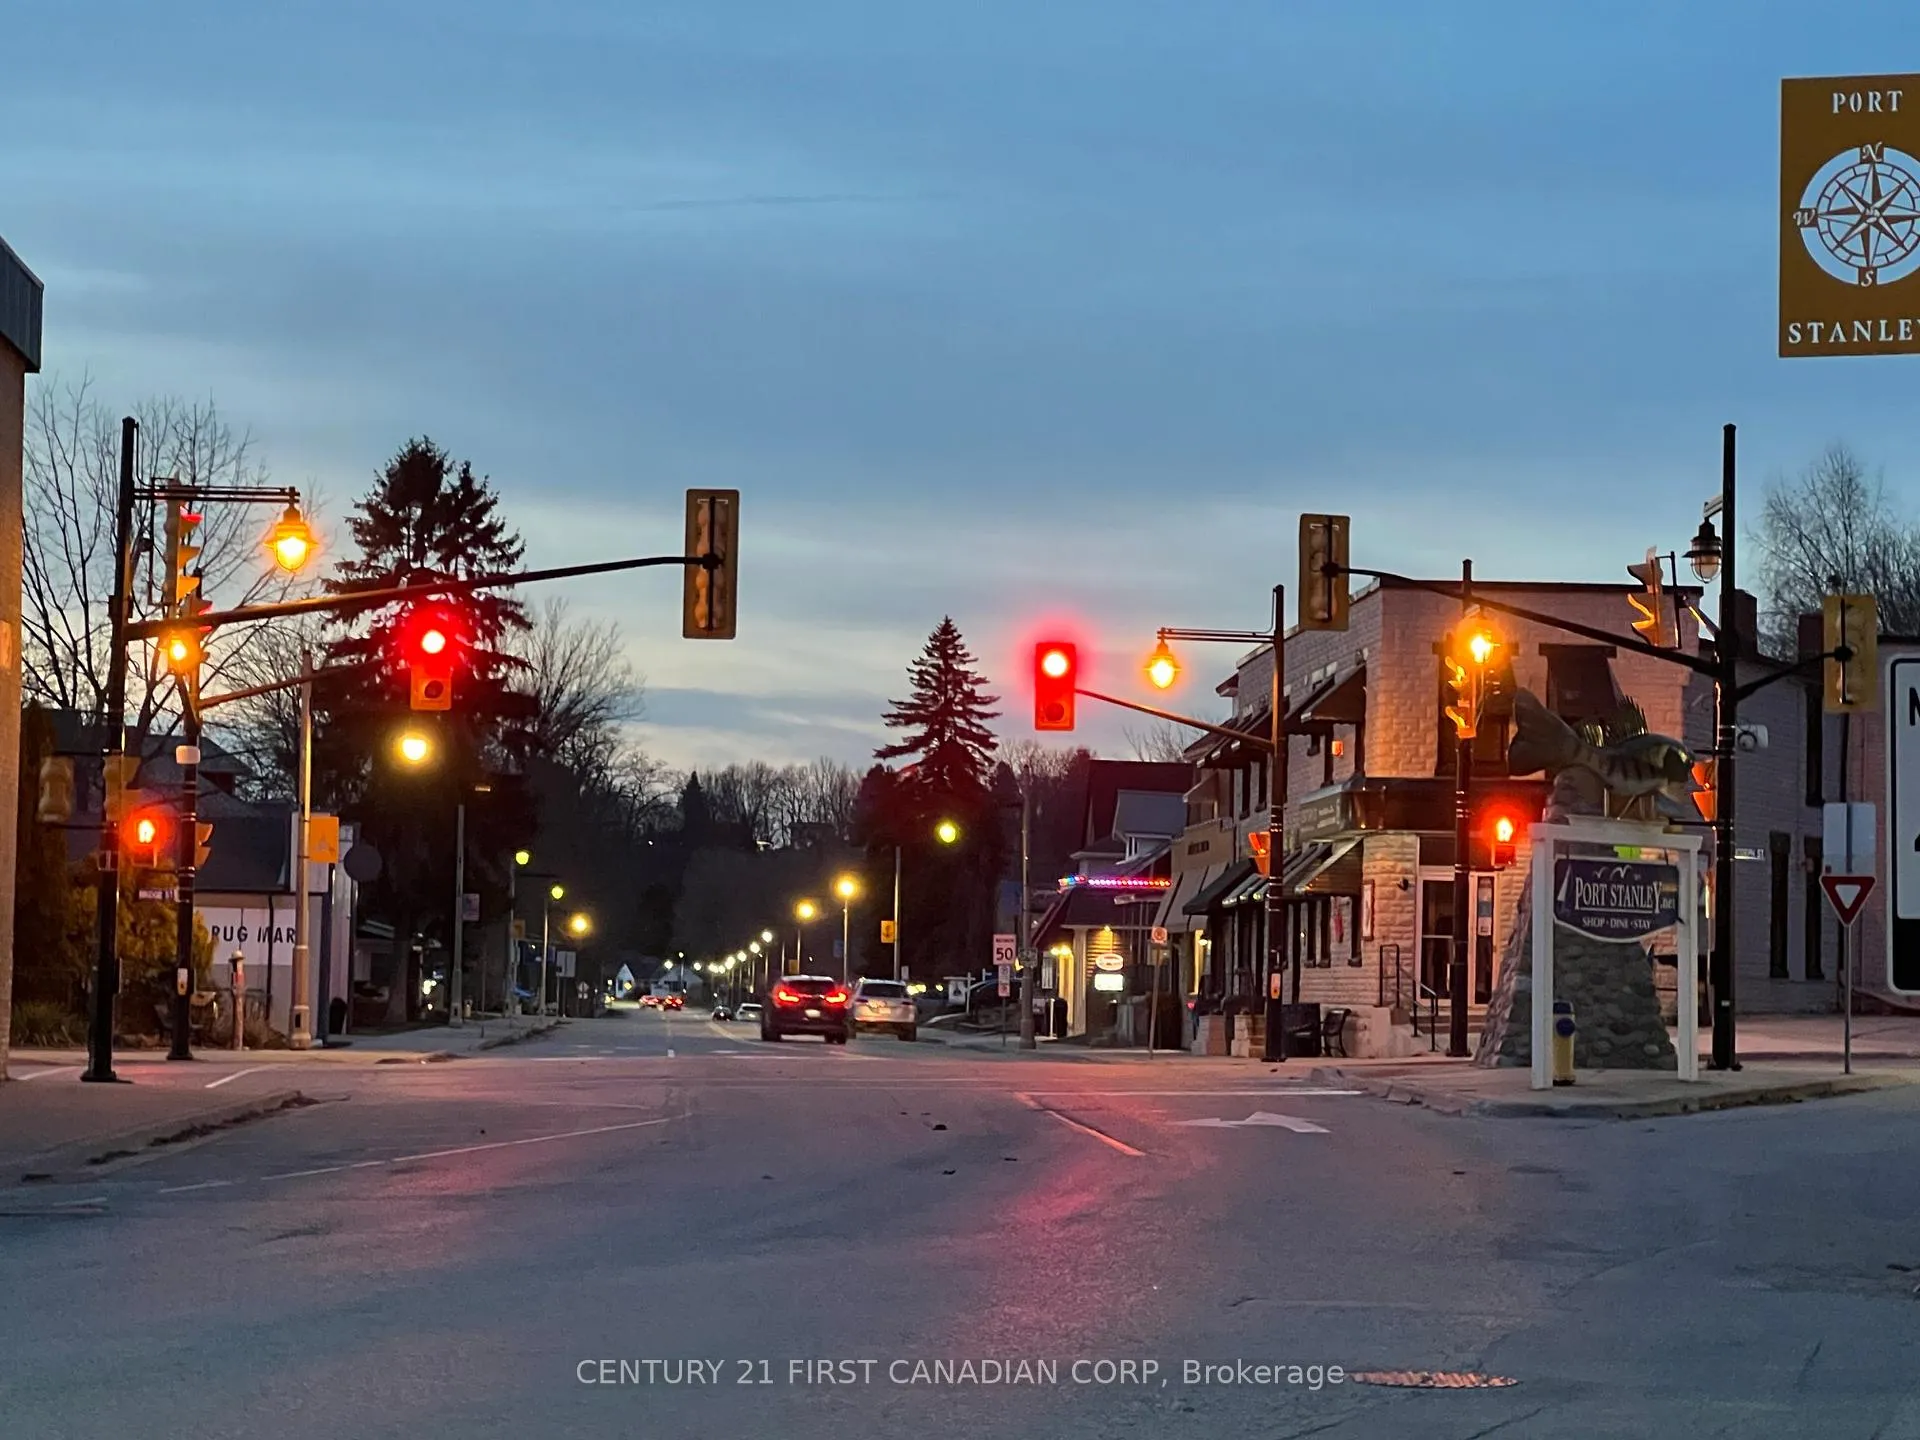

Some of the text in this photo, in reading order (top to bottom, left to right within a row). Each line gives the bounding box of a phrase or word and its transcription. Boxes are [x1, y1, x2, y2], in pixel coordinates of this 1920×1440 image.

[1832, 90, 1903, 114] PORT
[1862, 142, 1883, 163] N
[1793, 208, 1816, 227] W
[1860, 270, 1875, 288] S
[1575, 877, 1607, 910] PORT
[1582, 916, 1606, 928] SHOP
[1632, 919, 1652, 930] STAY
[211, 926, 297, 943] RUG MAR
[996, 947, 1013, 961] 50
